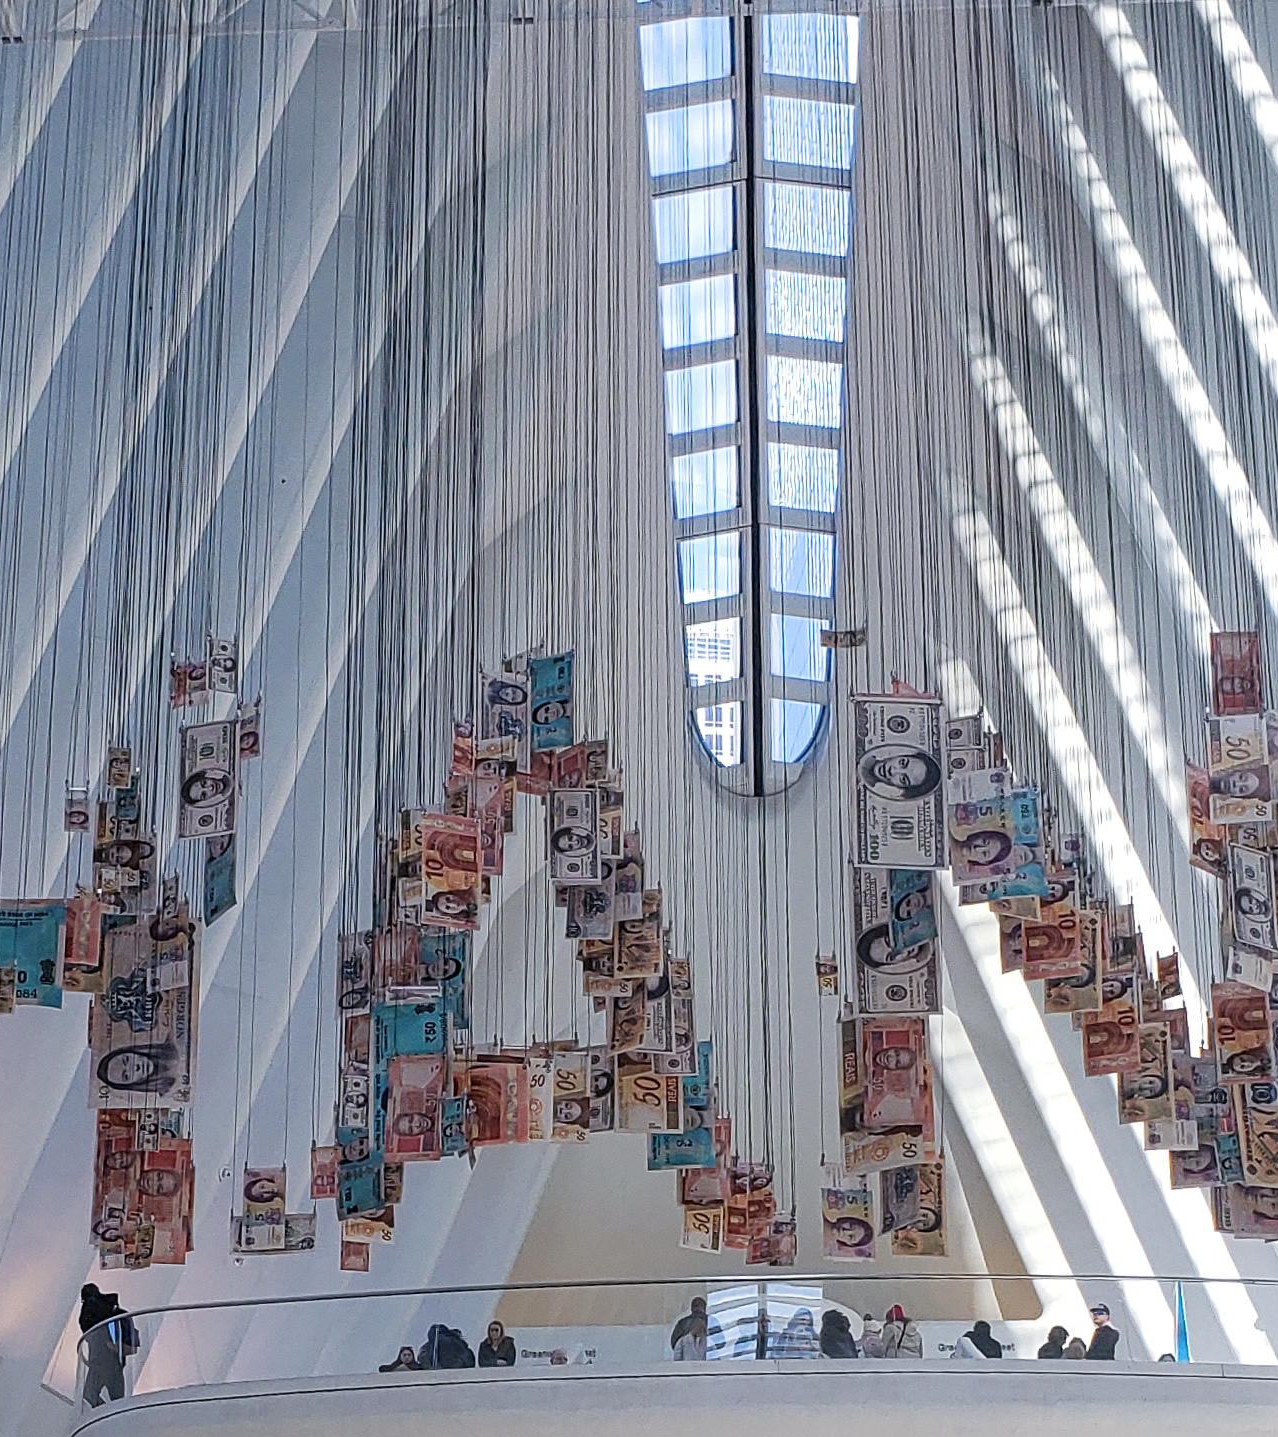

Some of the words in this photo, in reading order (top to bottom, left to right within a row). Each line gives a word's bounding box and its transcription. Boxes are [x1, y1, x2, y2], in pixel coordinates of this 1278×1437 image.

[1225, 735, 1251, 760] 50
[979, 805, 993, 816] 5
[1192, 807, 1204, 825] 10
[1255, 805, 1267, 817] 50
[869, 833, 880, 860] 100
[424, 858, 444, 880] 10
[1058, 910, 1075, 929] 10
[1117, 1007, 1134, 1028] 10
[1218, 1024, 1235, 1045] 10
[844, 1052, 856, 1083] REAIS
[529, 1074, 546, 1088] 50
[556, 1069, 578, 1091] 50
[667, 1076, 677, 1103] REAIS
[633, 1076, 662, 1107] 50
[902, 1141, 917, 1159] 50
[847, 1195, 858, 1205] 5
[694, 1212, 710, 1235] 50
